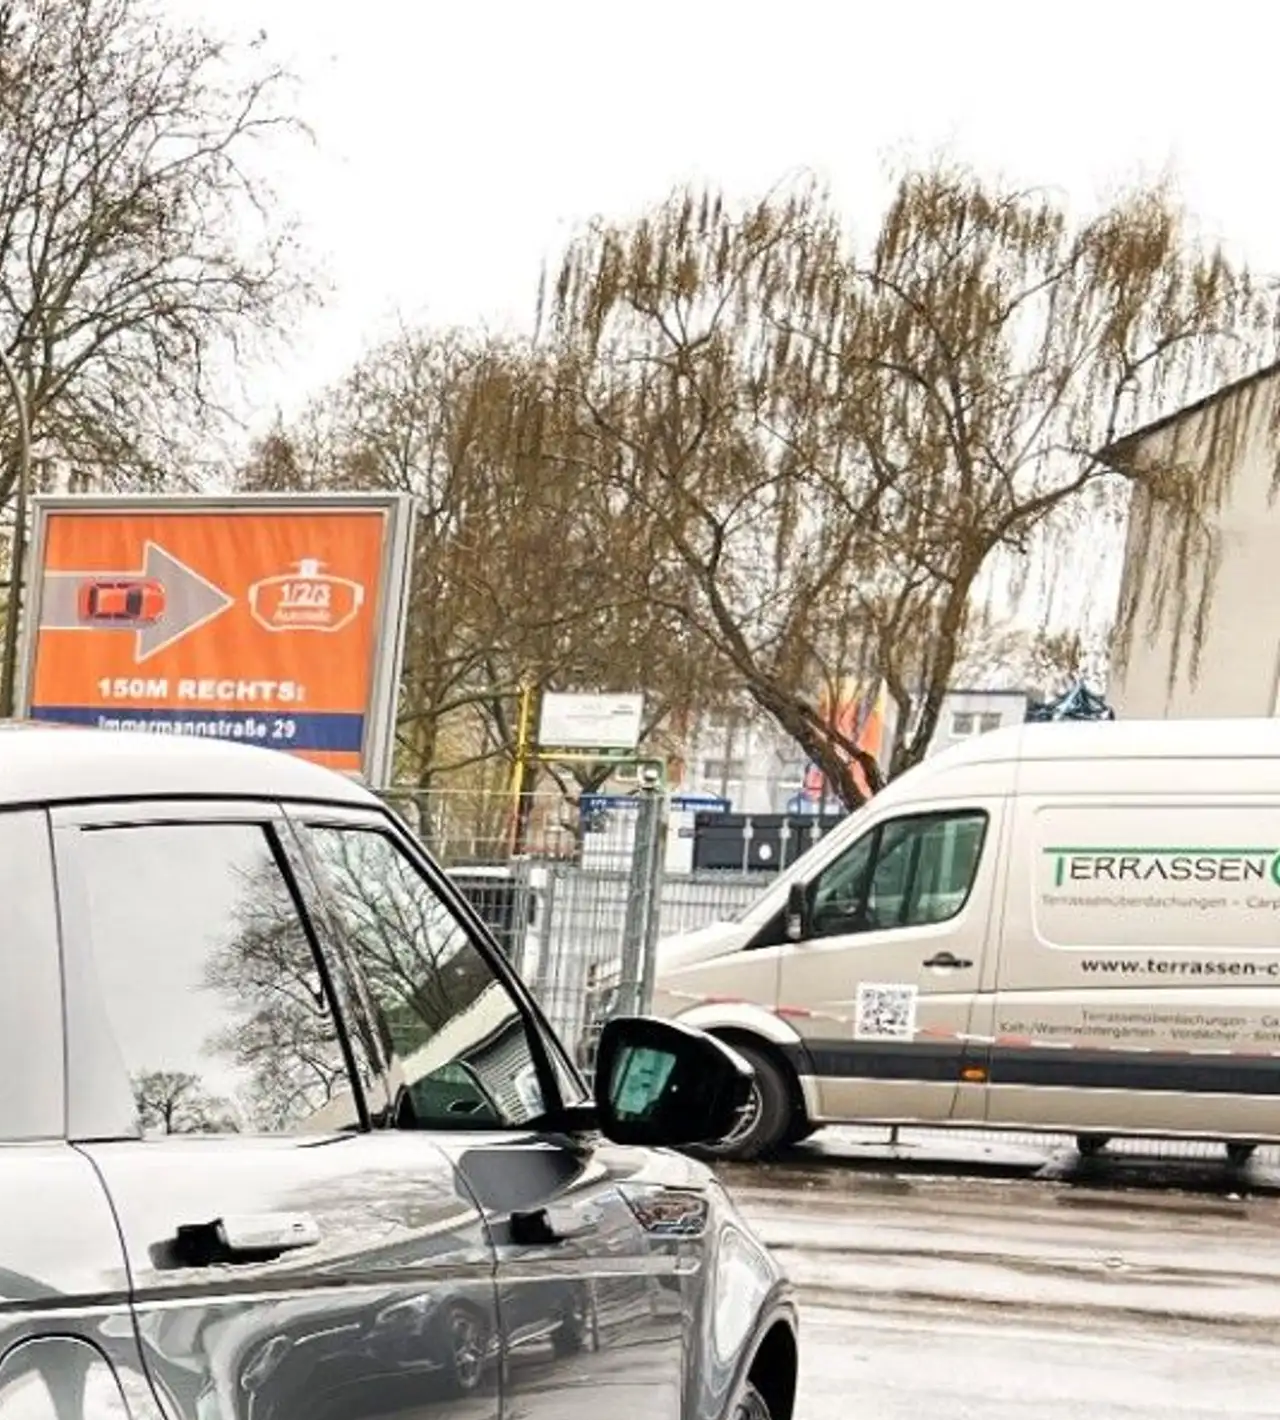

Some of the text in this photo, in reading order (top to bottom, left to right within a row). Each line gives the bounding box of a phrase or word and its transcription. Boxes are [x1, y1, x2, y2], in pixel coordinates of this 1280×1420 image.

[97, 677, 307, 701] 150M RECHTS:
[271, 719, 297, 738] 29
